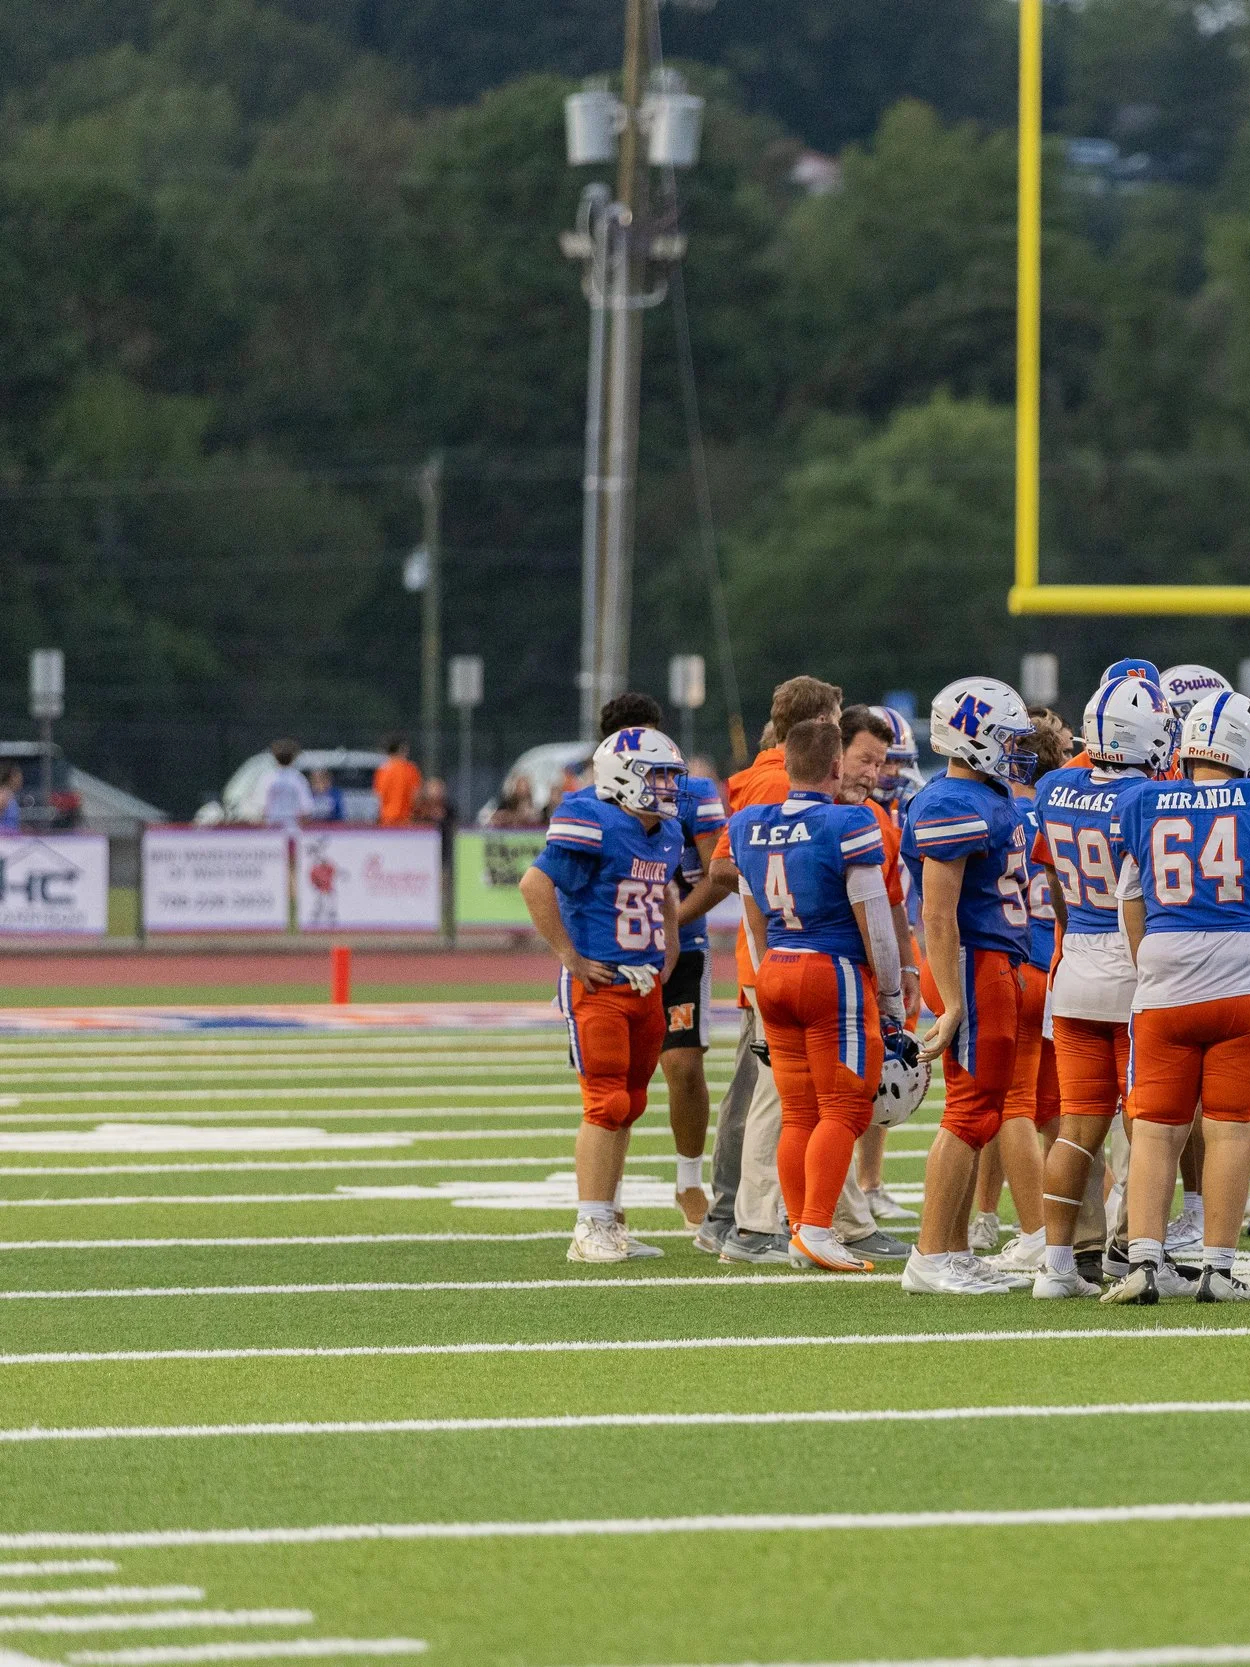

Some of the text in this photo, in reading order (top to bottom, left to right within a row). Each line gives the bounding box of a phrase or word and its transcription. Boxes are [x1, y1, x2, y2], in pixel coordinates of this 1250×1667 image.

[1170, 675, 1221, 696] Bruins
[948, 694, 993, 738] N
[613, 729, 645, 753] N
[1087, 748, 1124, 763] Riddell
[1188, 746, 1230, 763] Riddell
[1047, 786, 1118, 813] SALINAS
[1155, 787, 1247, 810] MIRANDA
[749, 822, 812, 846] LEA
[630, 858, 668, 882] BRUINS
[1044, 819, 1119, 910] 59
[1151, 815, 1244, 906] 64
[764, 852, 804, 931] 4
[667, 1002, 696, 1033] N
